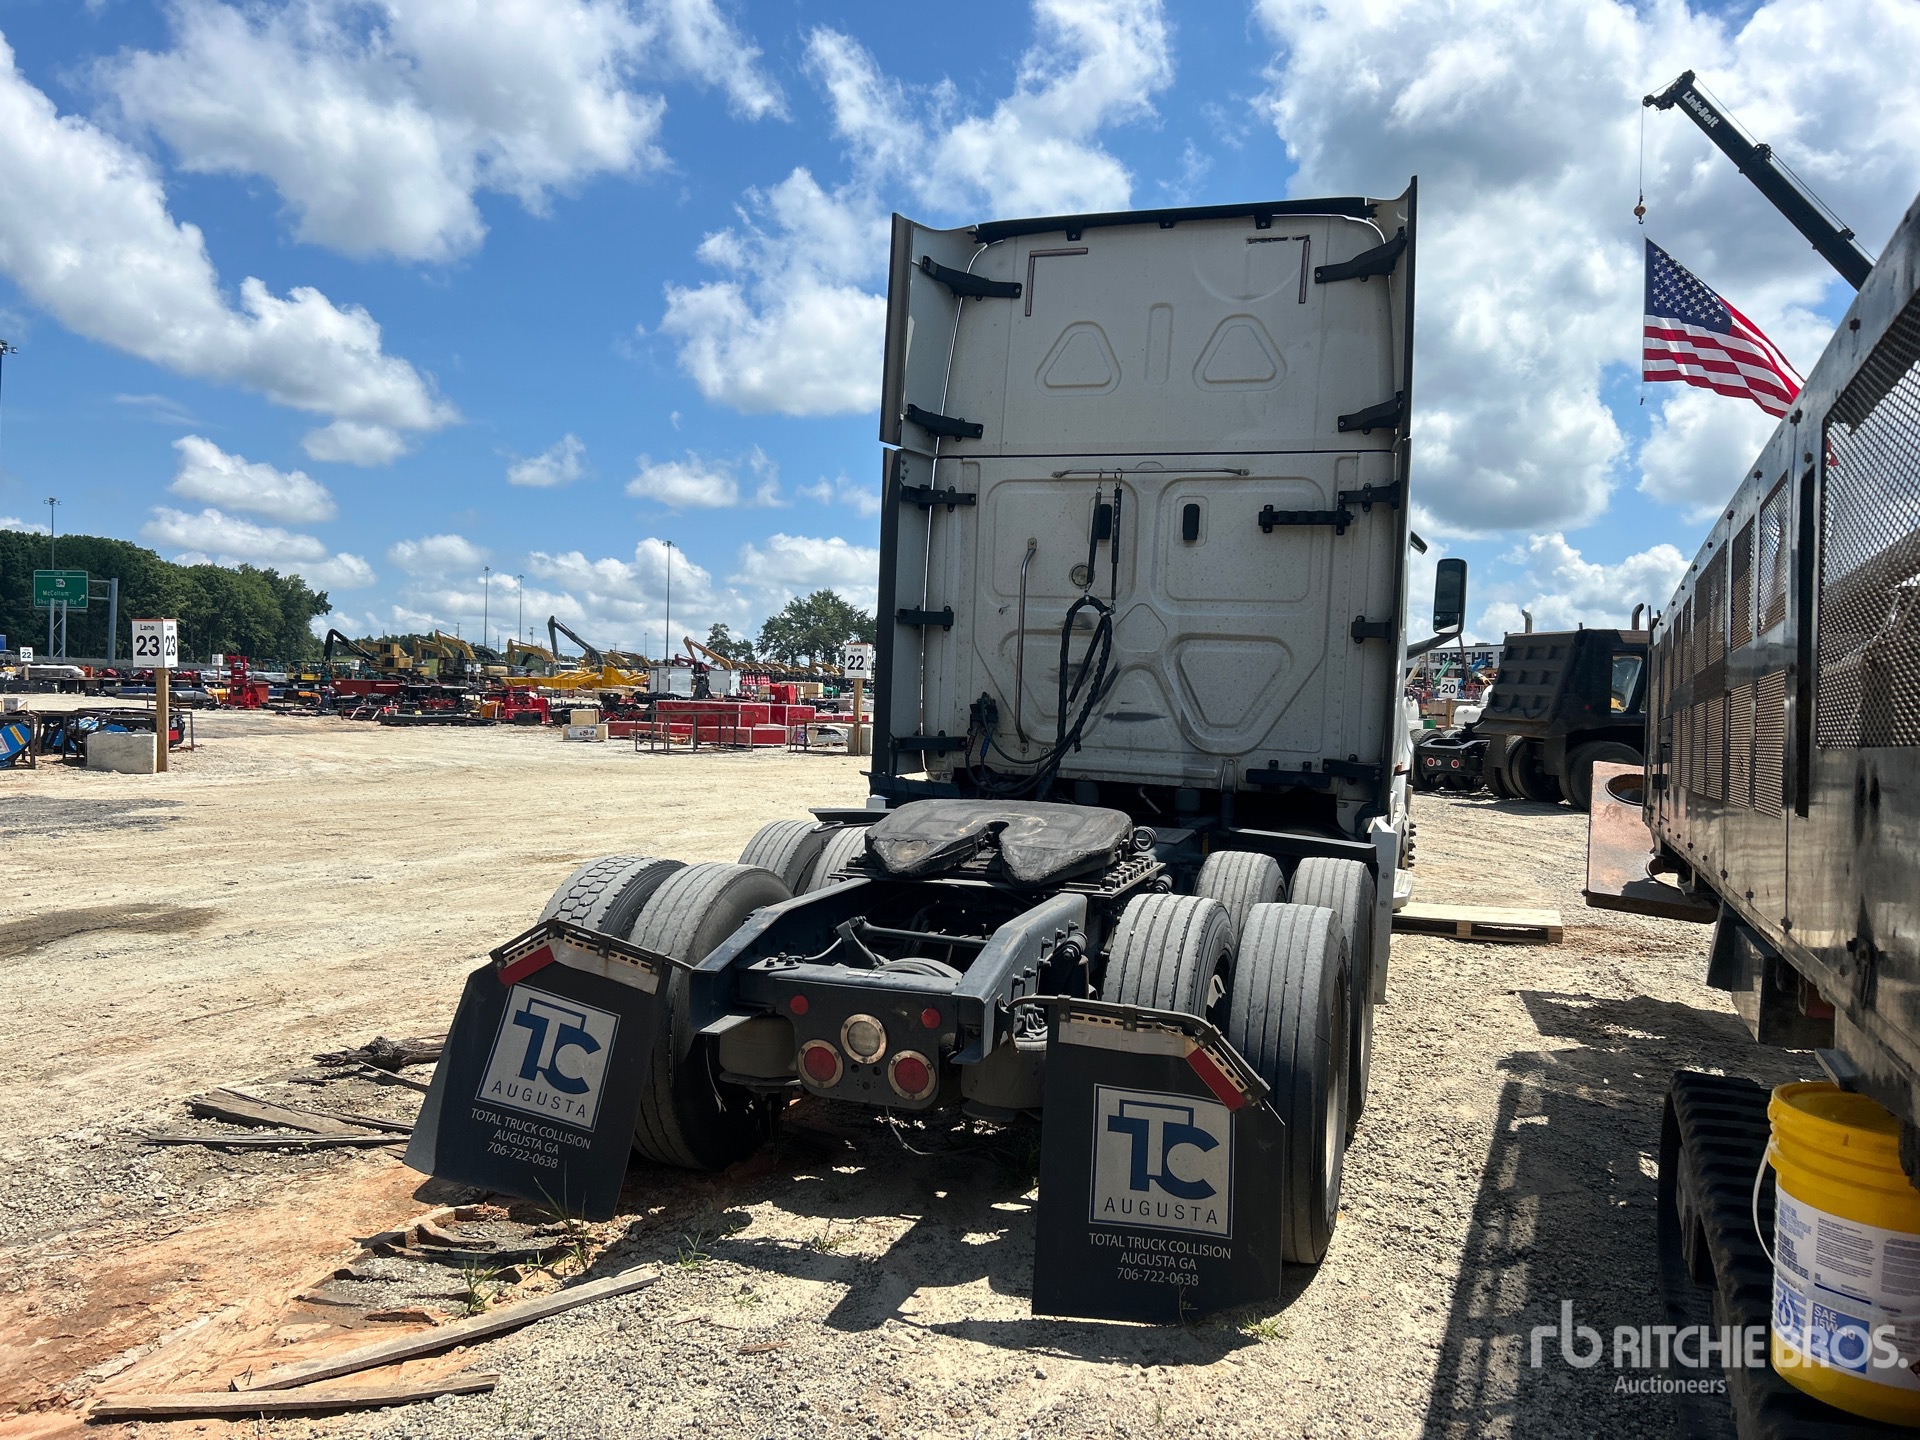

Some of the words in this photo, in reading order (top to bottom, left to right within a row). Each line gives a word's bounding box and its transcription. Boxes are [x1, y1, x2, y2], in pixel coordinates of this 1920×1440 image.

[1682, 90, 1719, 128] Link-Belt
[21, 651, 32, 659] 22
[136, 635, 160, 657] 23
[165, 635, 176, 656] 23
[847, 655, 865, 671] 22
[1441, 684, 1456, 694] 20
[491, 1080, 586, 1118] AUGUSTA
[471, 1107, 502, 1126] TOTAL
[504, 1116, 538, 1135] TRUCK
[538, 1126, 592, 1150] COLLISION
[493, 1129, 543, 1150] AUGUSTA
[543, 1142, 560, 1155] GA
[486, 1141, 559, 1169] 706-722-0638
[1103, 1196, 1218, 1225] AUGUSTA
[1088, 1232, 1126, 1248] TOTAL
[1127, 1236, 1167, 1252] TRUCK
[1168, 1240, 1232, 1260] COLLISION
[1120, 1251, 1177, 1269] AUGUSTA
[1178, 1257, 1197, 1270] GA
[1117, 1267, 1200, 1286] 706-722-0638
[1813, 1305, 1838, 1324] SAE
